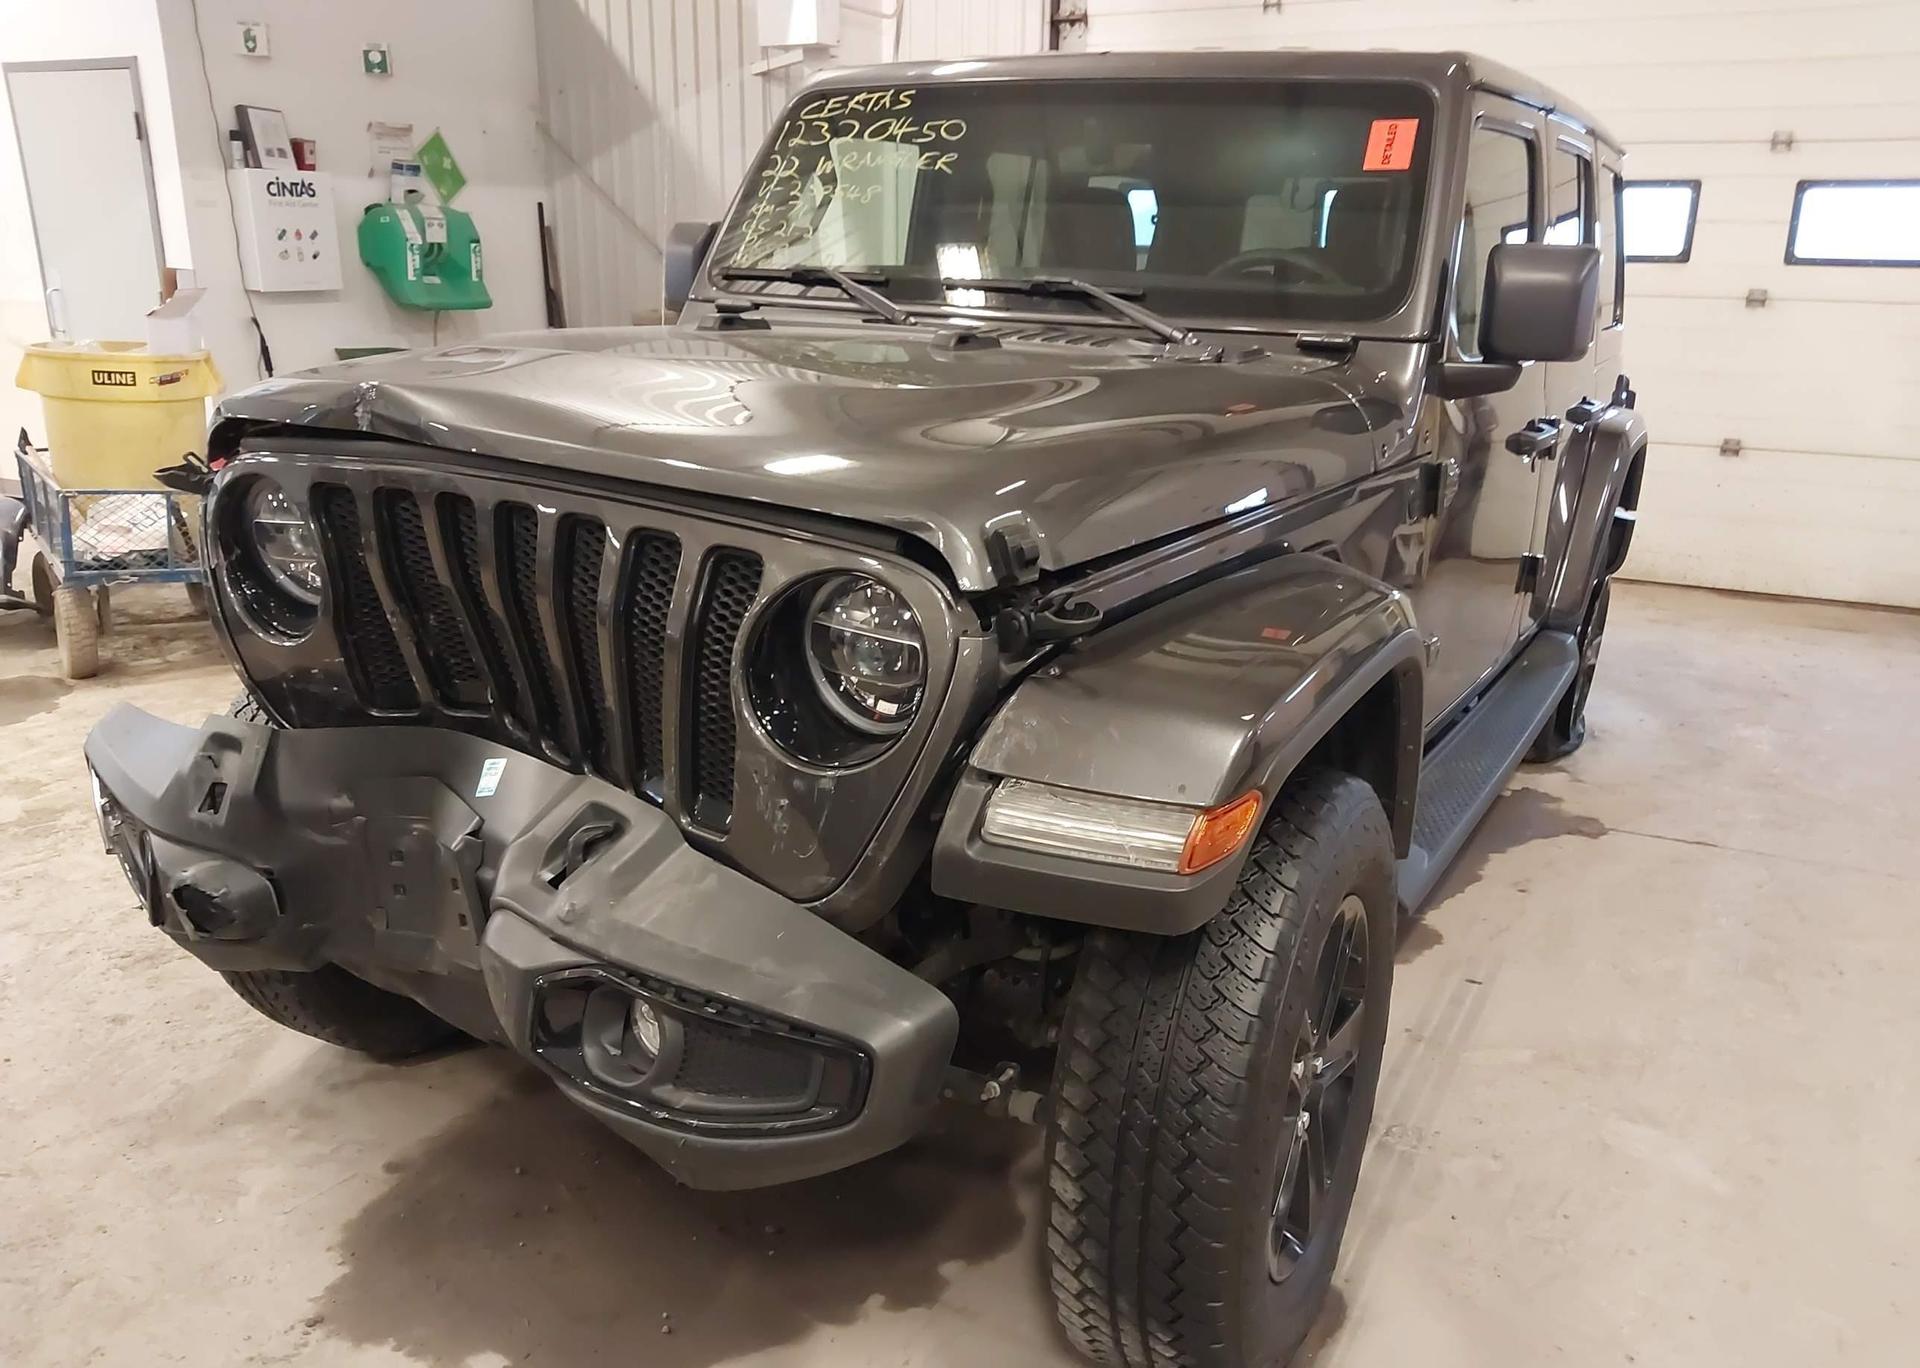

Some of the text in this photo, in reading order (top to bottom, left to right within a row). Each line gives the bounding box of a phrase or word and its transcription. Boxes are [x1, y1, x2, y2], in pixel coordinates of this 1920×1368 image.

[774, 116, 967, 150] 12320450
[762, 155, 799, 179] 22
[94, 372, 135, 385] ULINE
